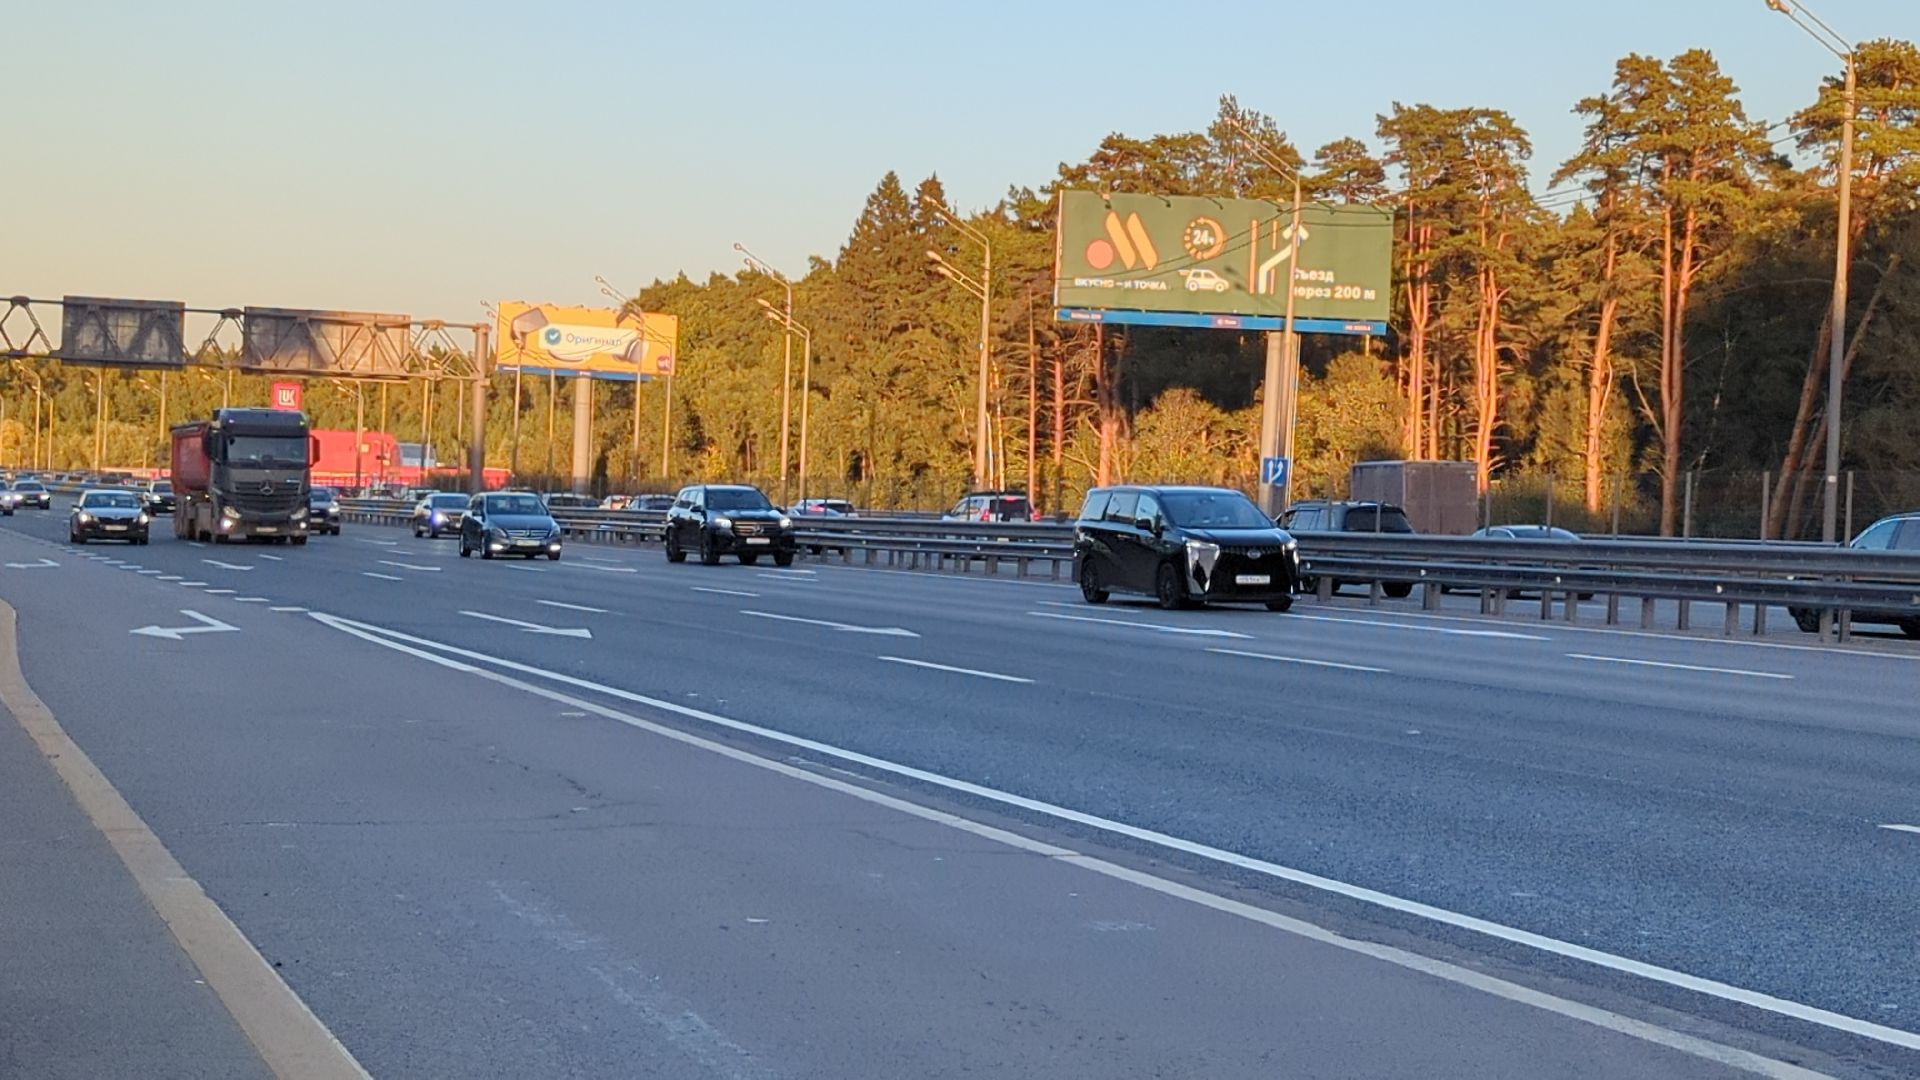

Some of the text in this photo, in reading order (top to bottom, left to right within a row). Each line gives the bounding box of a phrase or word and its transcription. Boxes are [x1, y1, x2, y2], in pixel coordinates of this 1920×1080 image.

[1074, 278, 1114, 289] ВКУСНО
[1134, 281, 1167, 290] ТОЧКА
[1334, 285, 1361, 299] 200
[566, 333, 621, 347] Оригинал
